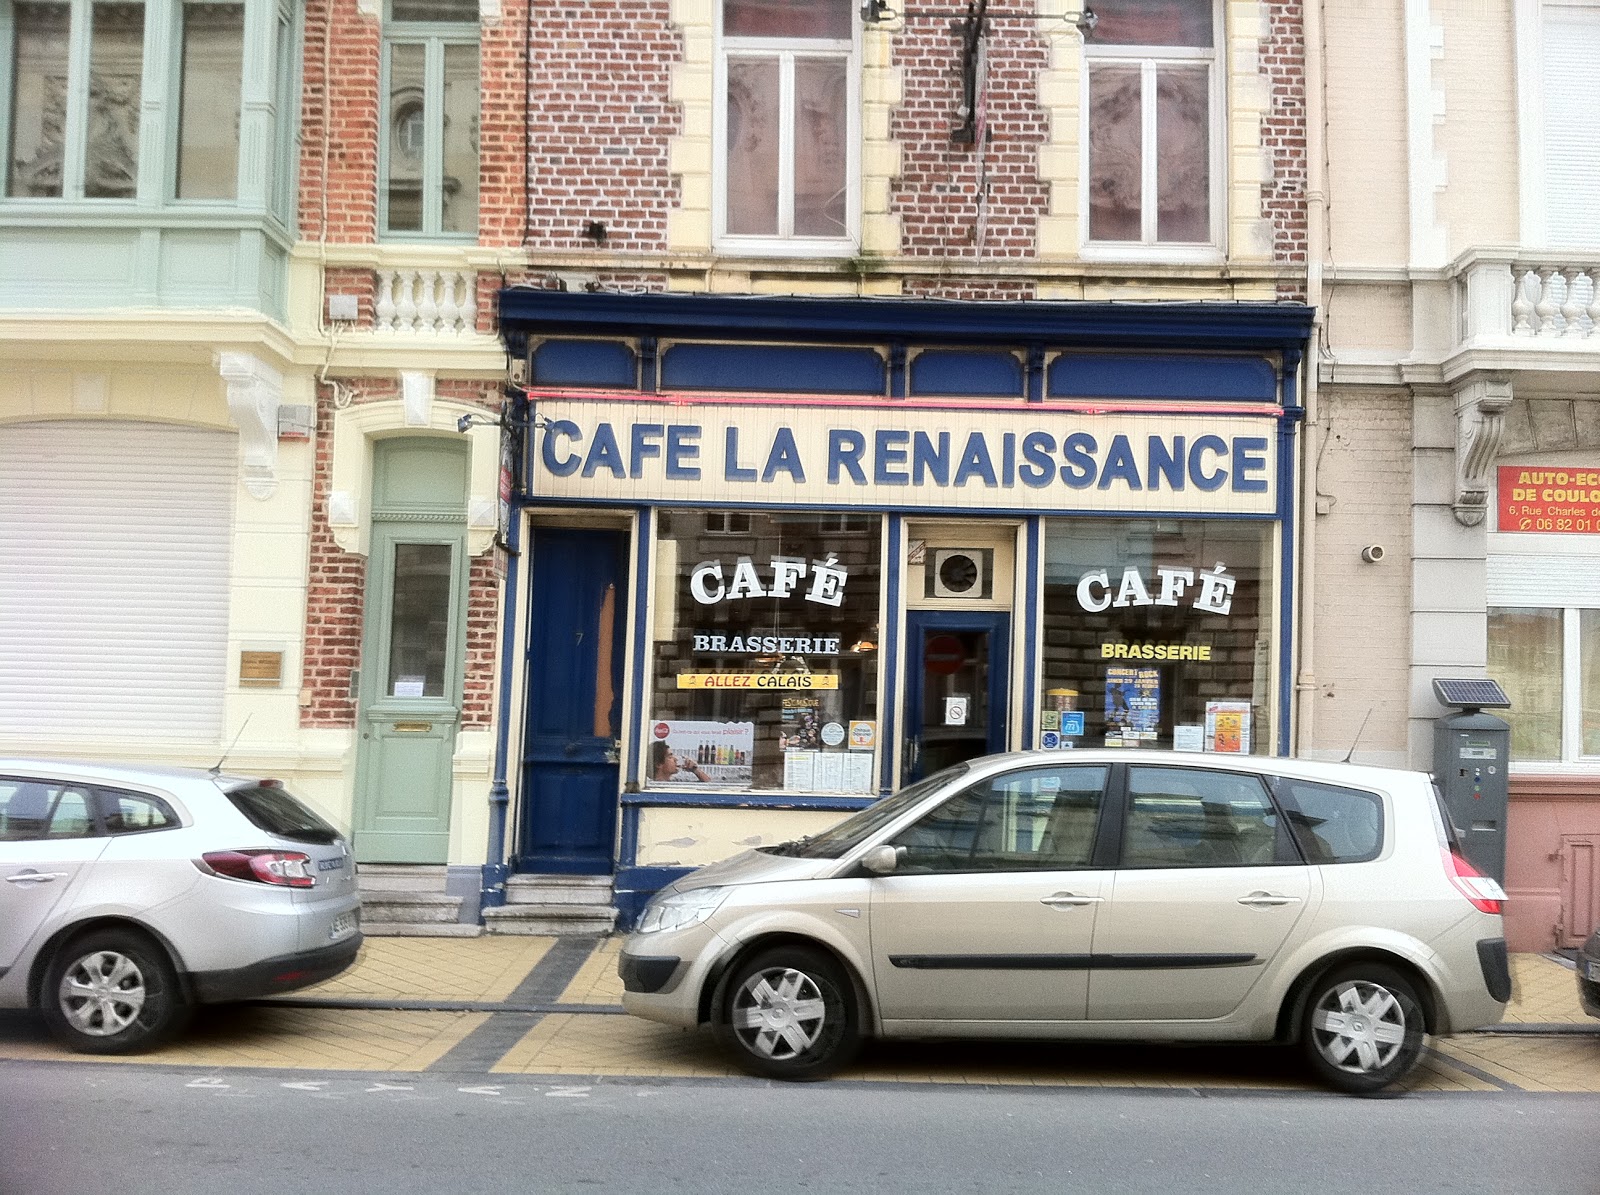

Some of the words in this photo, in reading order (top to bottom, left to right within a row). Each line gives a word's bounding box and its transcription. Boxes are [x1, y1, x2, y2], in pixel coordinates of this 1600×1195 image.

[541, 418, 702, 480] CAFE
[725, 426, 805, 484] LA
[828, 428, 1268, 493] RENAISSANCE
[1519, 471, 1600, 486] AUTO-EC
[1512, 488, 1537, 501] DE
[1509, 506, 1519, 516] 6,
[1521, 506, 1542, 515] Rue
[1547, 507, 1586, 517] Charles
[1536, 518, 1553, 530] 06
[1556, 519, 1572, 531] 82
[1576, 519, 1591, 531] 01
[690, 554, 848, 607] CAFÉ
[1077, 566, 1236, 615] CAFÉ
[693, 634, 840, 655] BRASSERIE
[1101, 643, 1212, 661] BRASSERIE
[704, 676, 751, 688] ALLEZ
[757, 676, 812, 688] CALAIS
